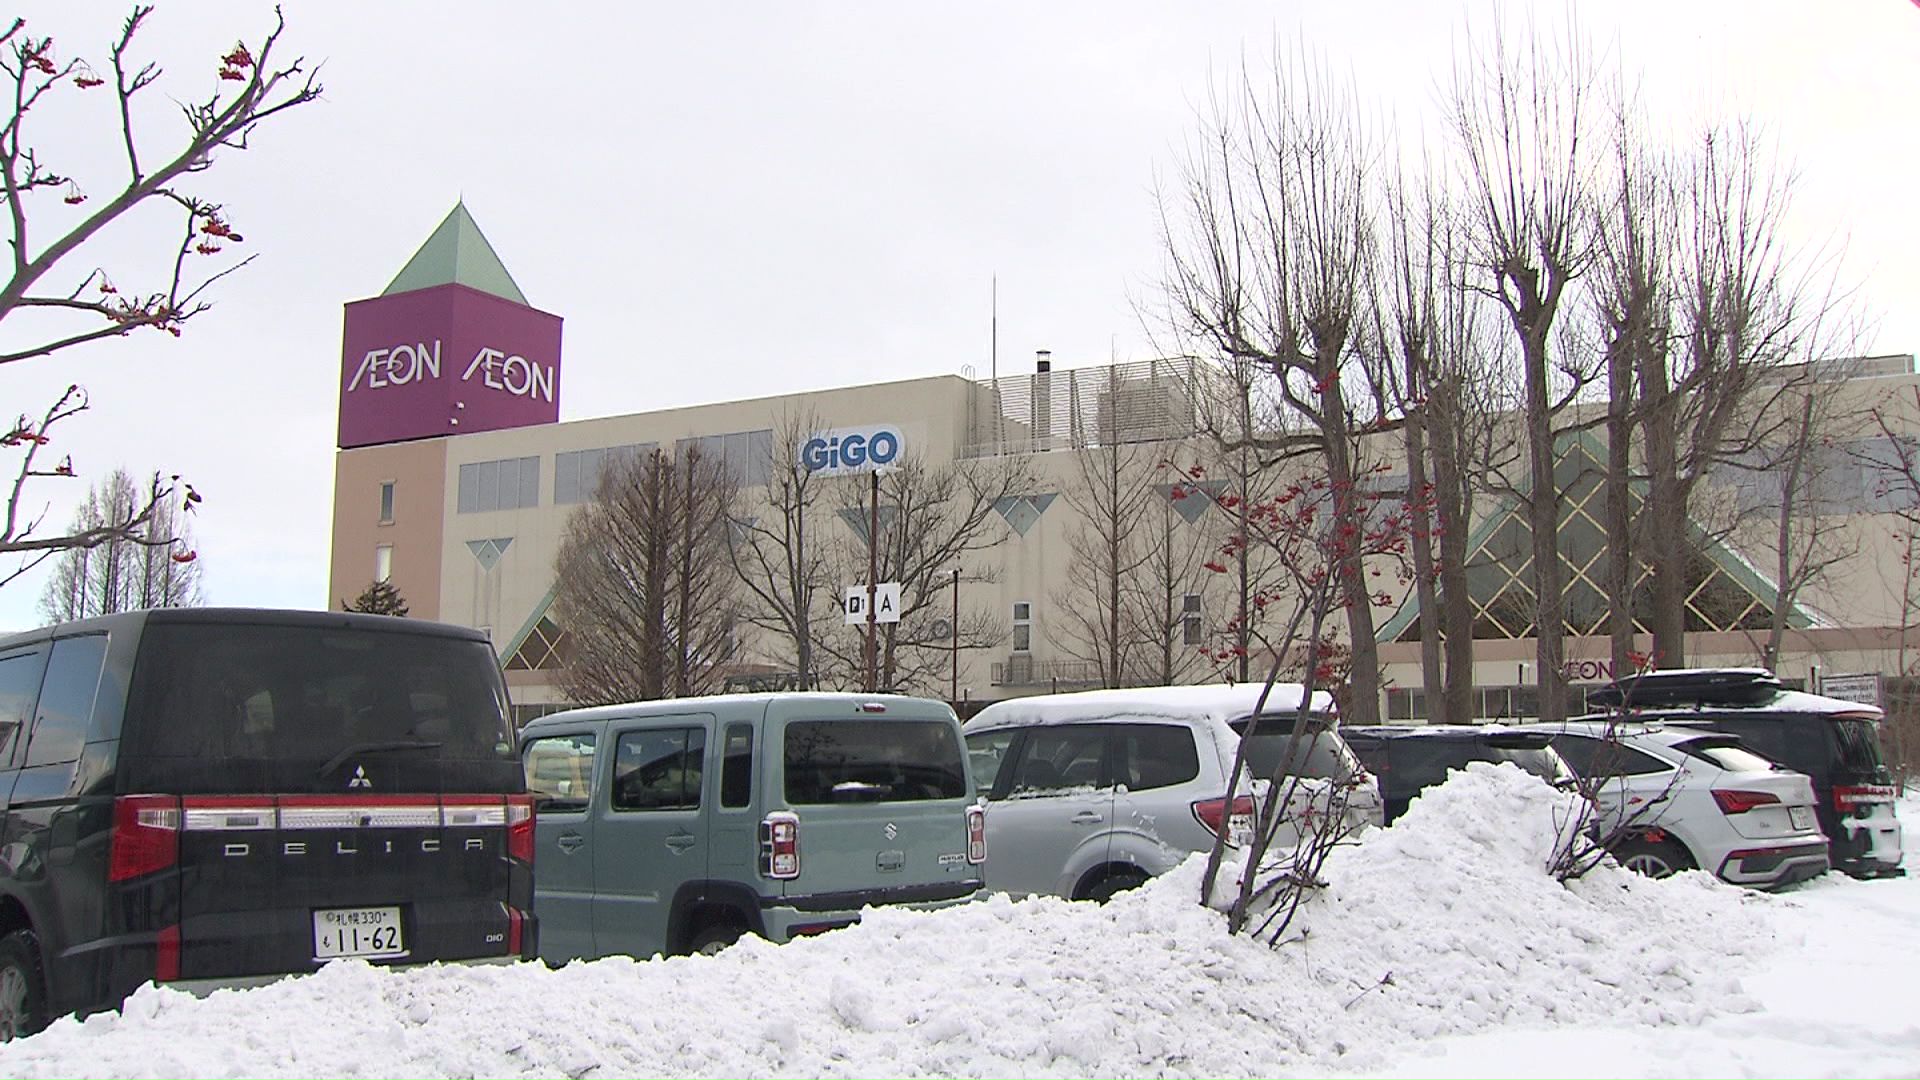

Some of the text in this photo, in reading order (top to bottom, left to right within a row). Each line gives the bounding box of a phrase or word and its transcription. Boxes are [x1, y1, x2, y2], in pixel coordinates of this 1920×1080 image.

[881, 593, 892, 612] A
[224, 838, 484, 857] DELICA
[339, 926, 398, 952] 11-62
